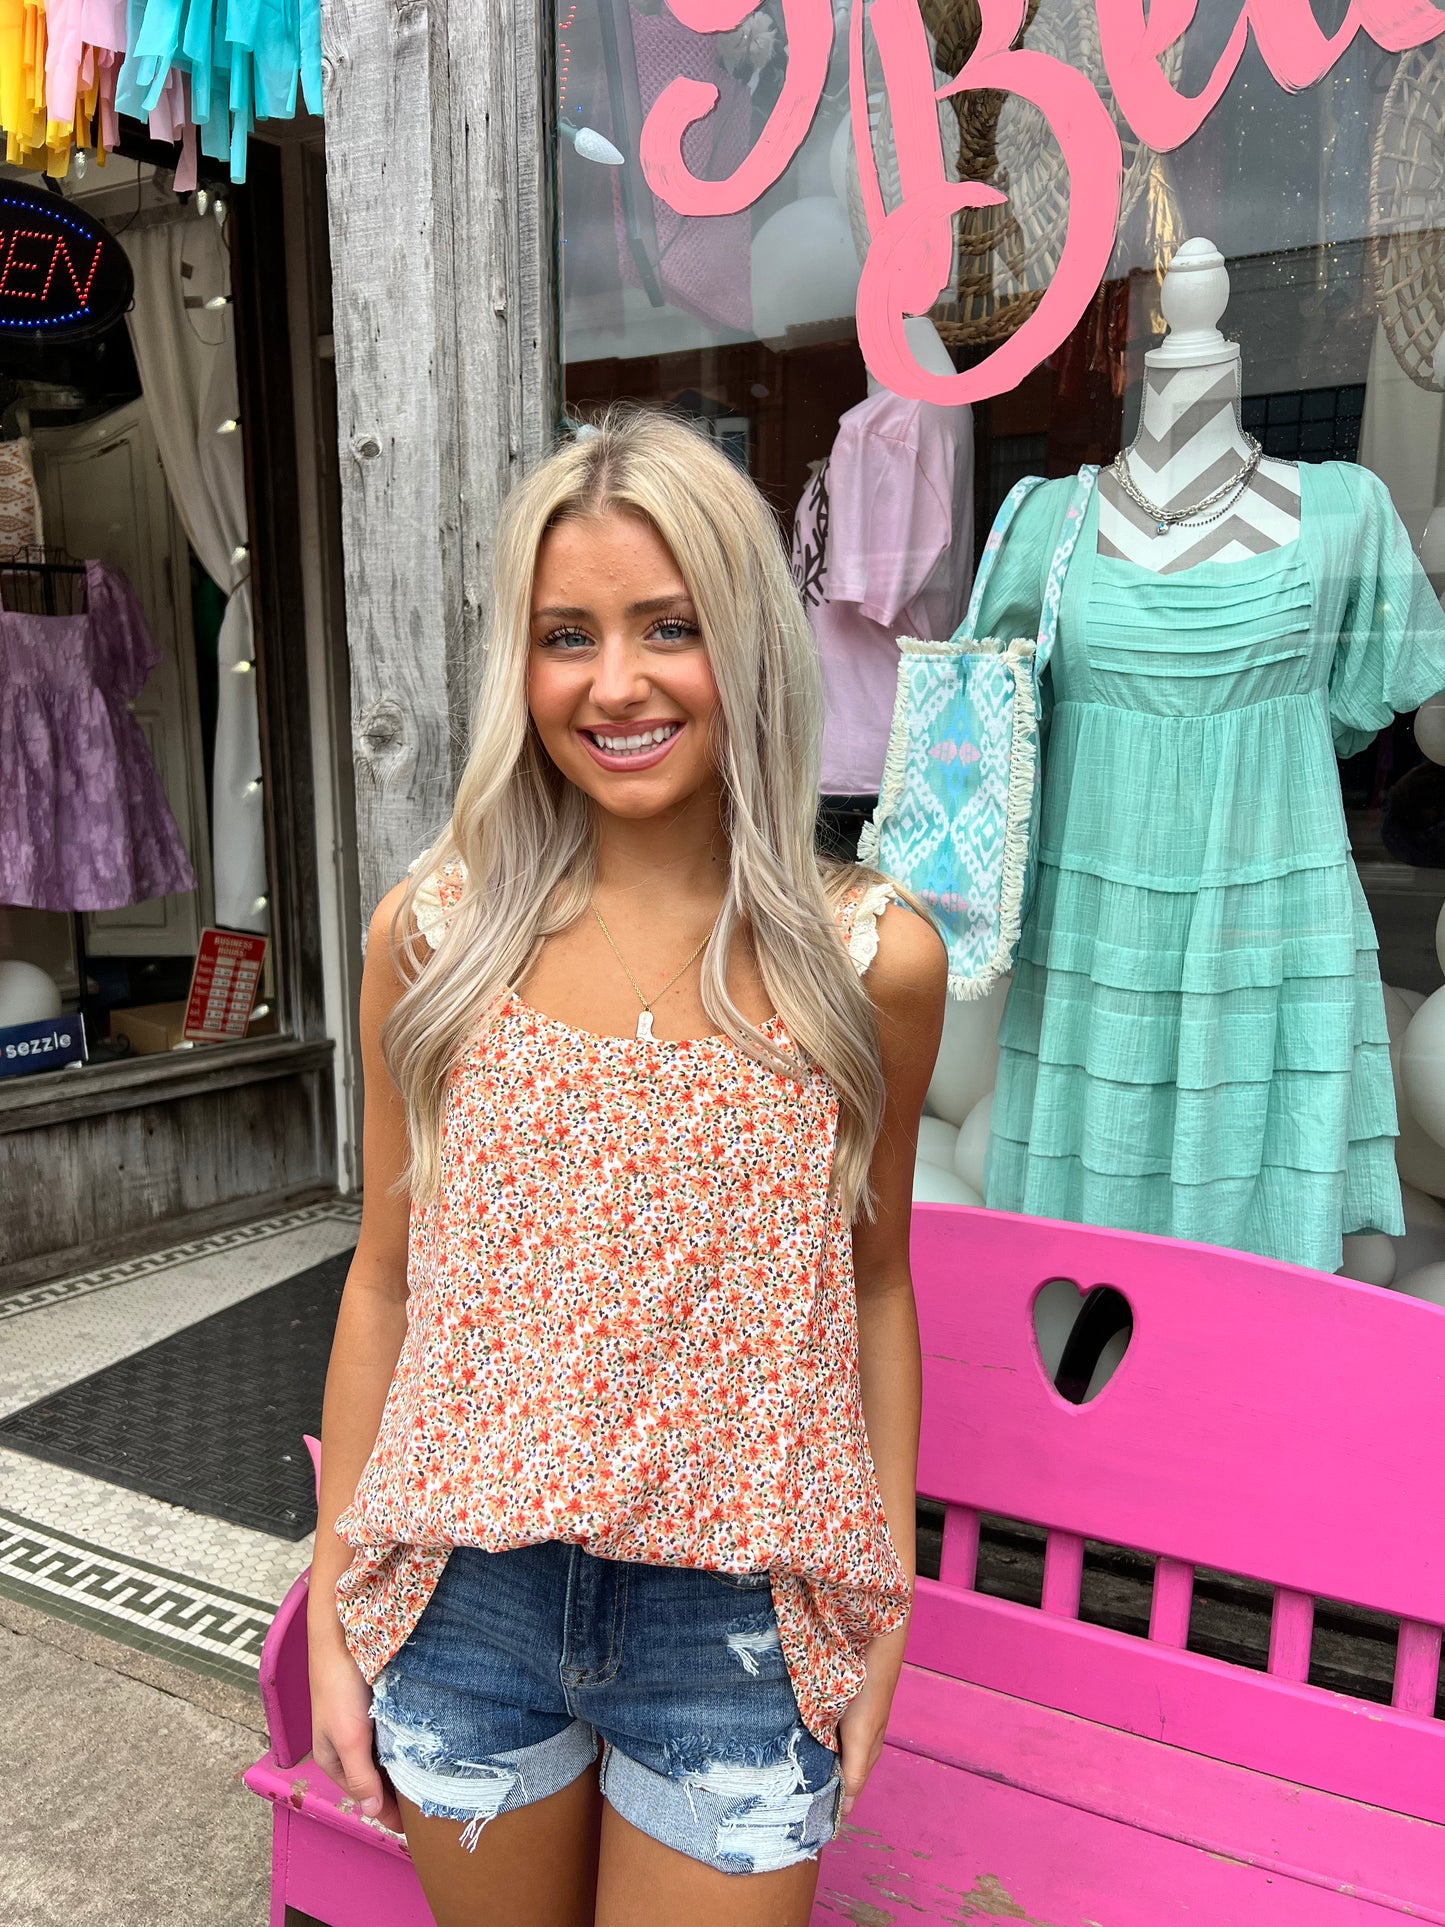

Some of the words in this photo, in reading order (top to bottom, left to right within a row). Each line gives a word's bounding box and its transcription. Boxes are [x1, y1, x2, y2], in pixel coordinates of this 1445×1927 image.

[0, 230, 102, 306] EN
[214, 935, 254, 951] BUSINESS
[6, 1031, 71, 1058] sezzle
